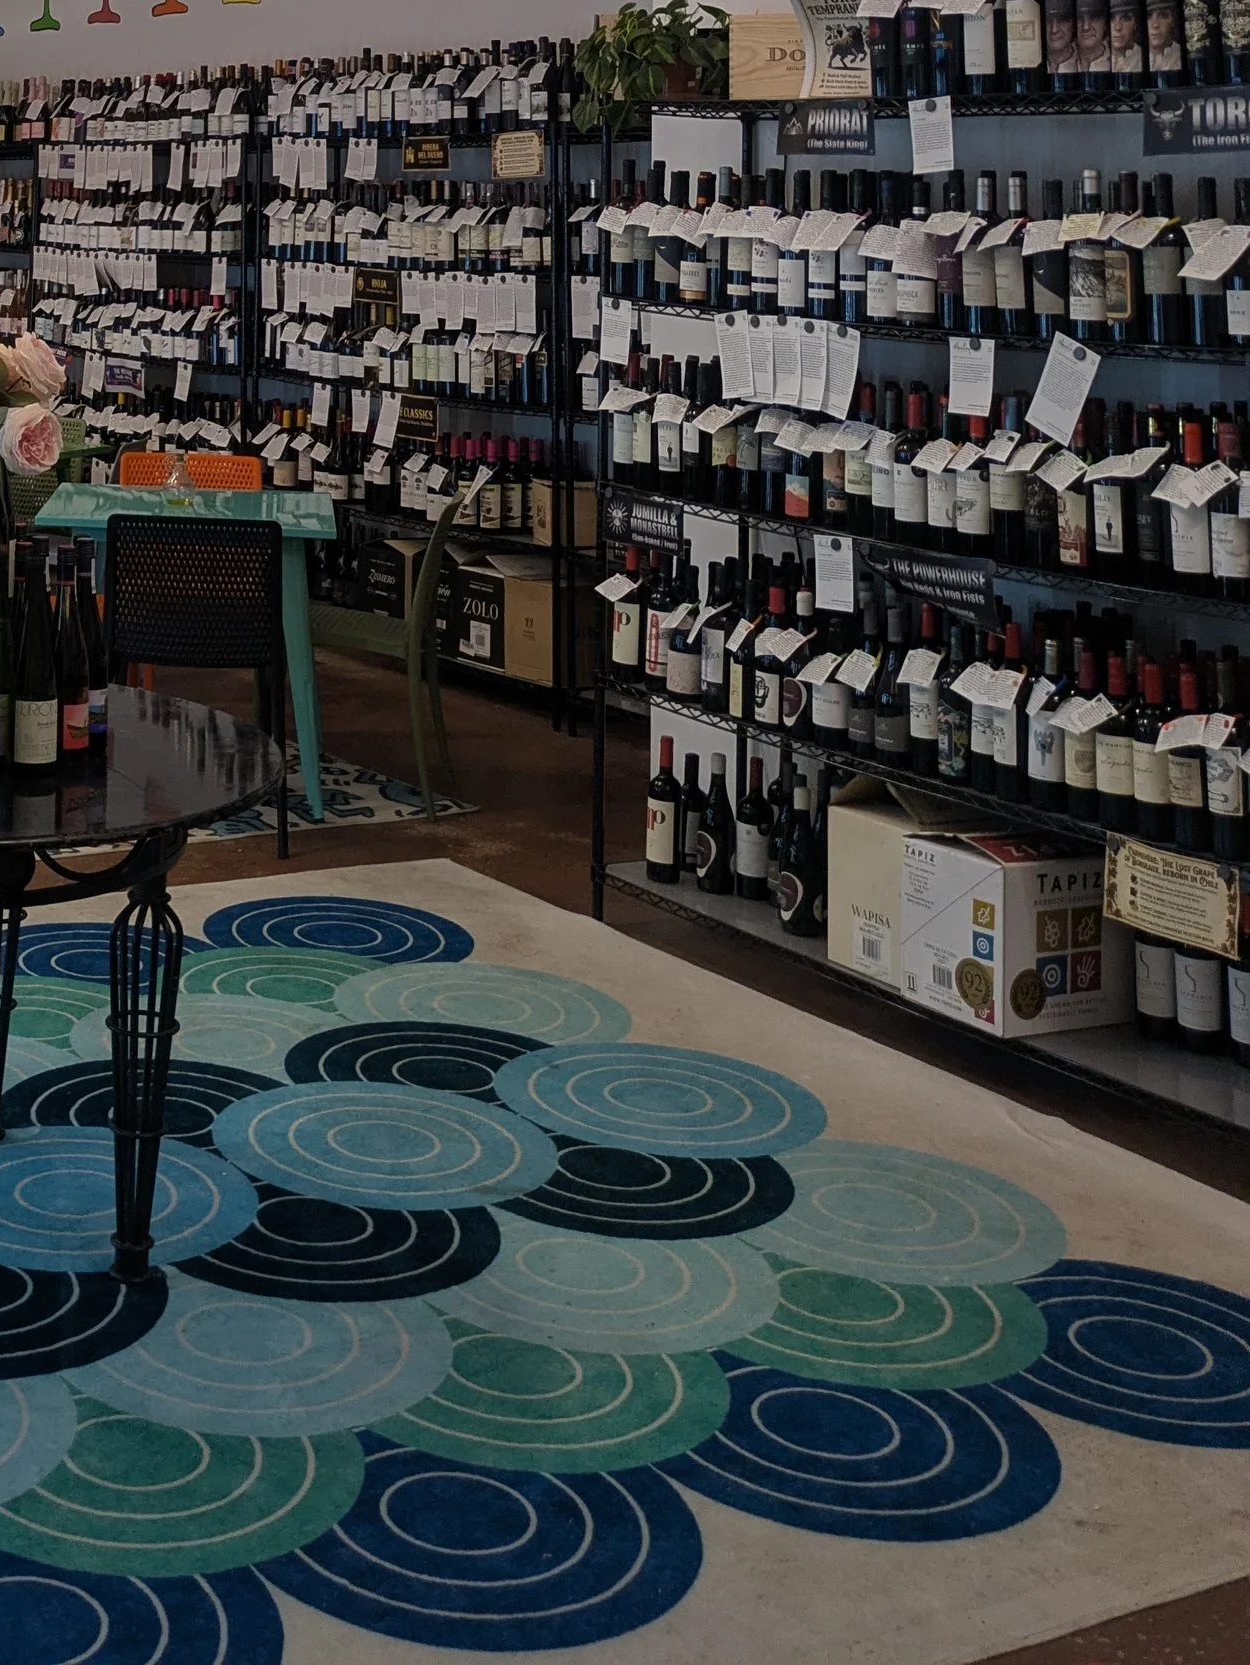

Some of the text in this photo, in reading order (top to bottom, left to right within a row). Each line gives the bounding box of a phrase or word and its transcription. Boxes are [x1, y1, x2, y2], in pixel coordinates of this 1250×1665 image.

[807, 109, 869, 135] PRIORAT
[1188, 97, 1250, 131] TOR
[807, 139, 868, 150] (The Slate King)
[1192, 135, 1214, 146] (The
[1217, 134, 1238, 145] Iron
[427, 151, 444, 159] DUERO
[403, 407, 433, 420] CLASSICS
[632, 503, 678, 526] JUMILLA &
[630, 517, 679, 539] MONASTRELL
[892, 558, 910, 575] THE
[912, 561, 986, 588] POWERHOUSE
[943, 587, 961, 601] Iron
[962, 589, 985, 605] Fists
[463, 597, 499, 620] ZOLO
[904, 844, 936, 863] TAPIZ
[1037, 873, 1104, 894] TAPIZ
[851, 904, 891, 928] WAPISA
[964, 971, 984, 993] 92
